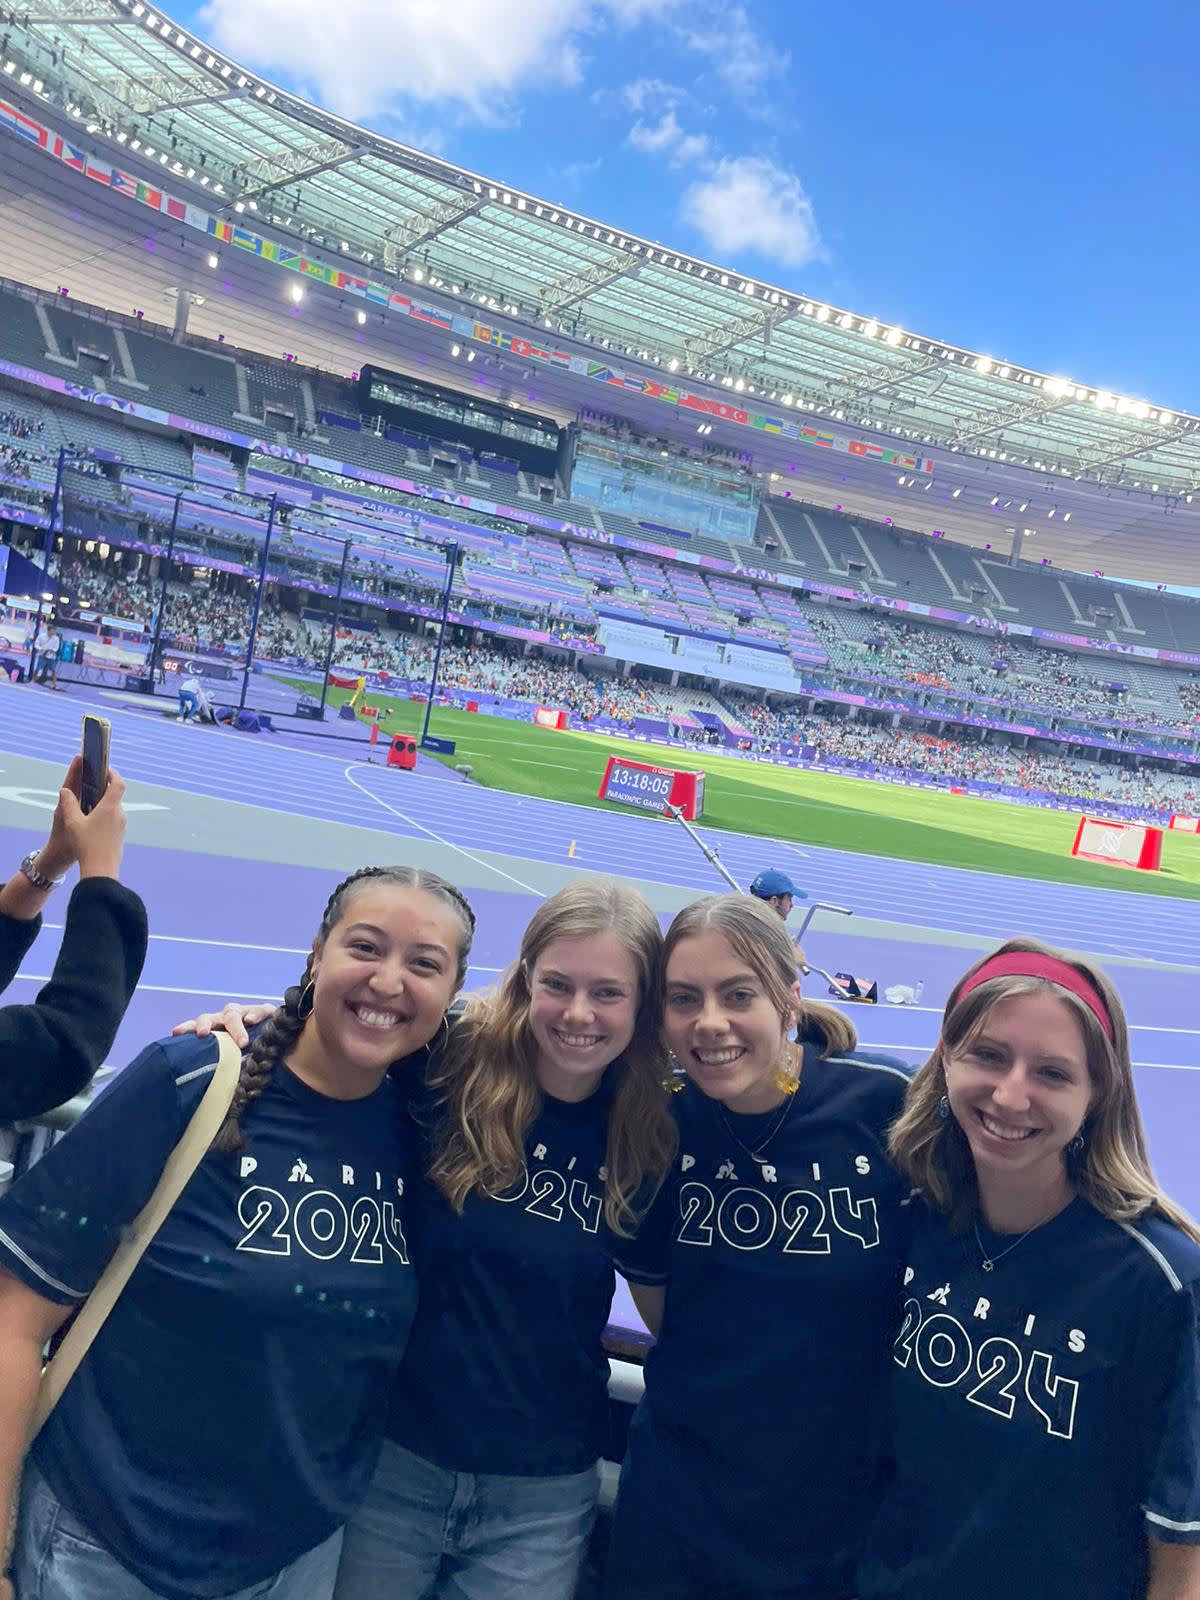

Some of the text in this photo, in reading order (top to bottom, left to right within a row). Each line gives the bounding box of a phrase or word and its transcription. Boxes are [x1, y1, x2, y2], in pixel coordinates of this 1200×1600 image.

[607, 790, 665, 811] PARALYMPIC GAMES
[611, 768, 670, 795] 13:18:05
[481, 1159, 603, 1234] 024
[533, 1143, 608, 1181] RIS
[235, 1185, 411, 1265] 2024
[677, 1182, 880, 1255] 2024
[893, 1298, 1079, 1440] 2024
